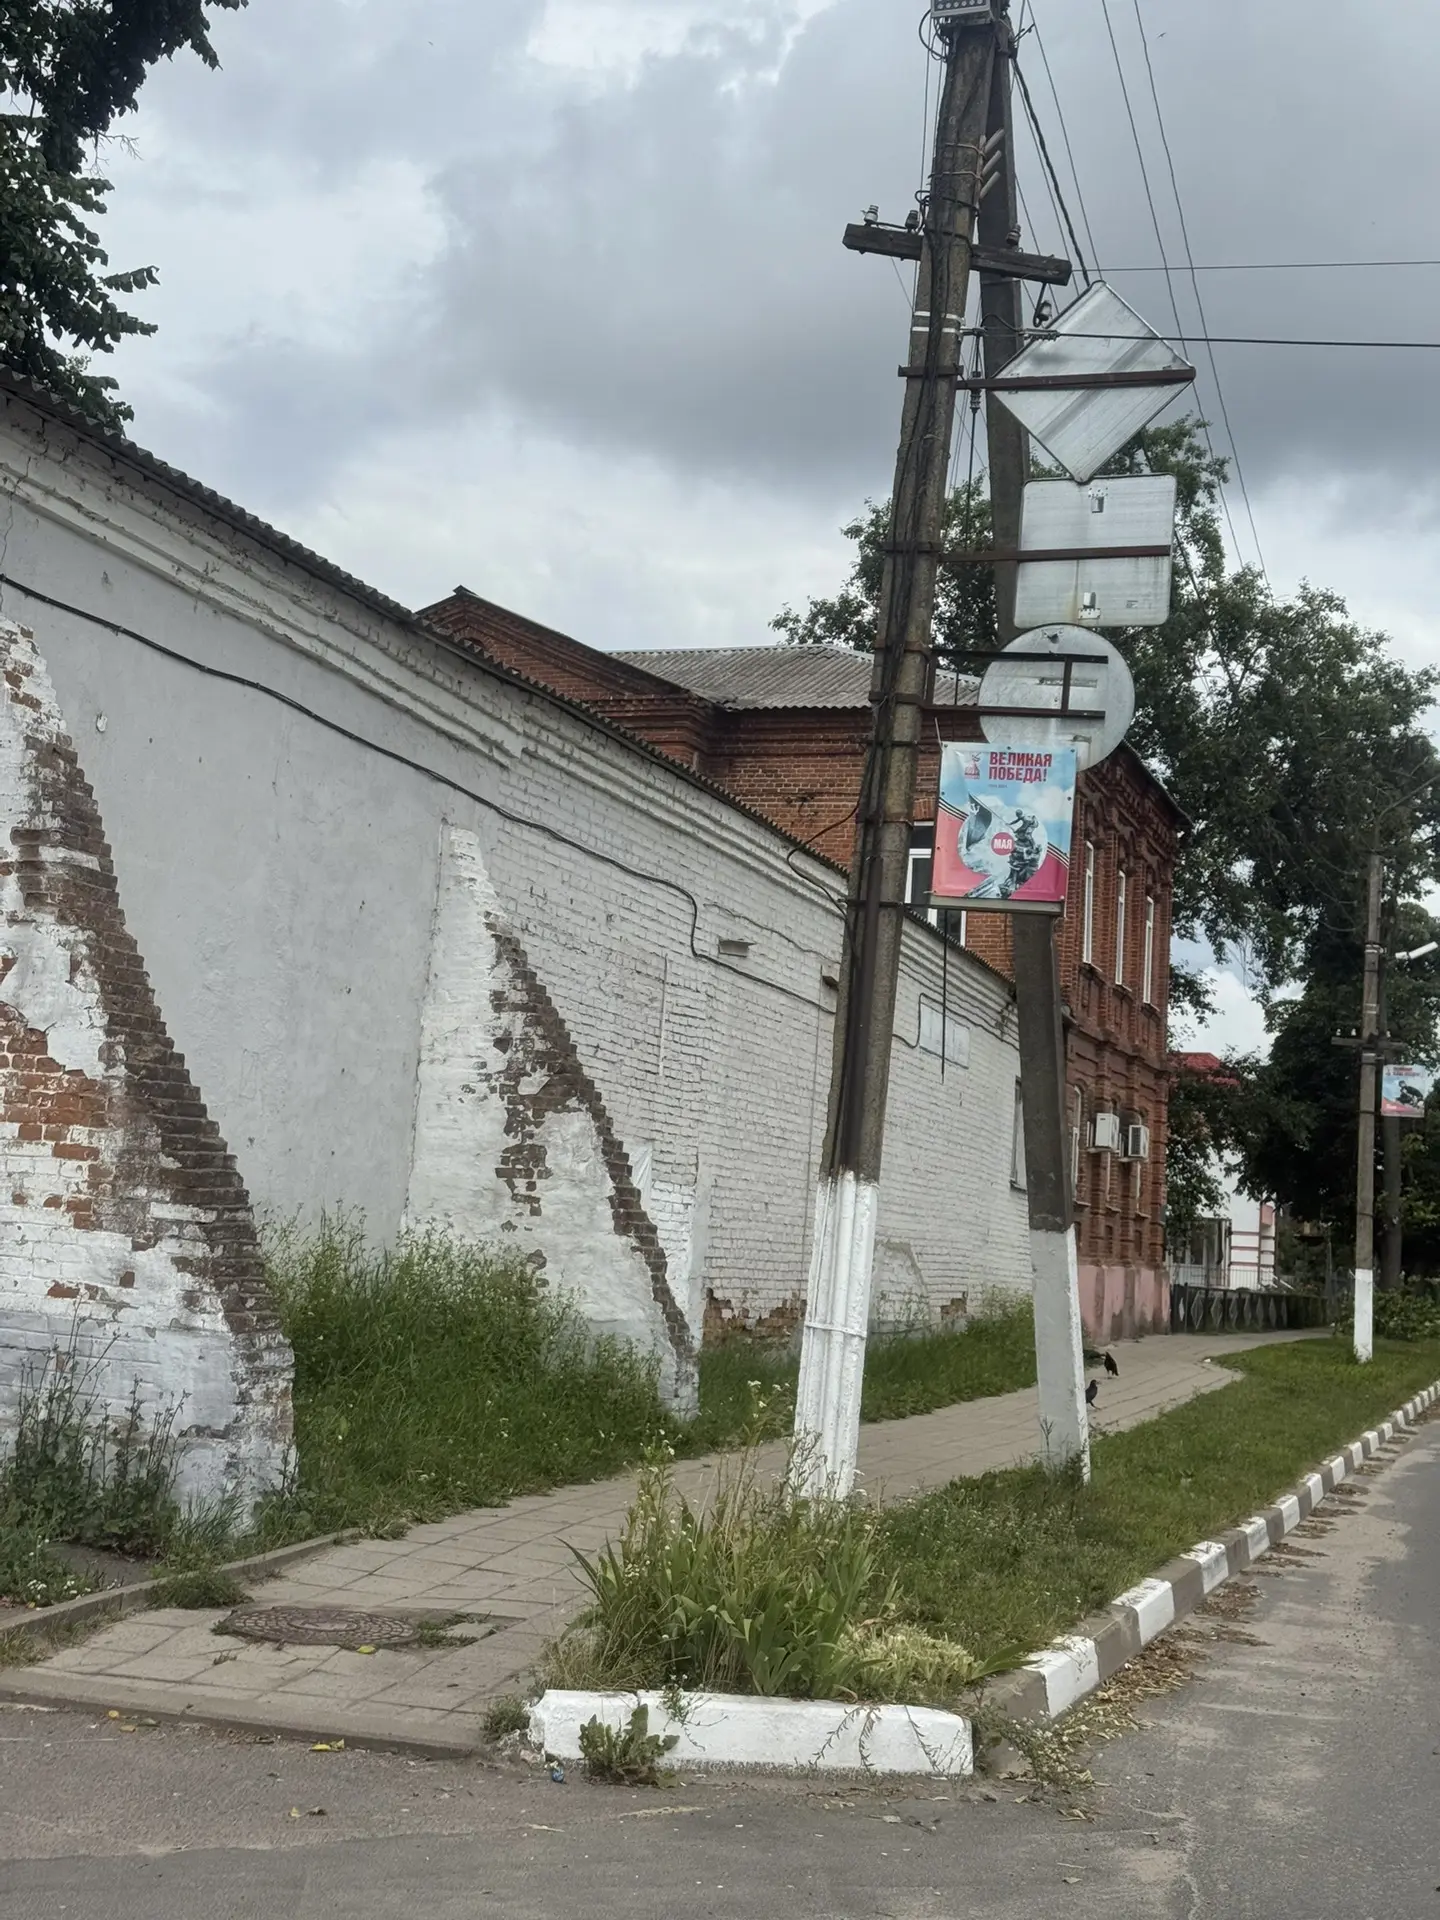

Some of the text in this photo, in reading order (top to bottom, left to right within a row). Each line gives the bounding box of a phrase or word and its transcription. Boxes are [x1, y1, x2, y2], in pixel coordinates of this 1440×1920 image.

[989, 751, 1053, 767] ВЕЛИКАЯ
[988, 766, 1047, 783] ПОБЕДА!
[993, 838, 1013, 850] МАЯ
